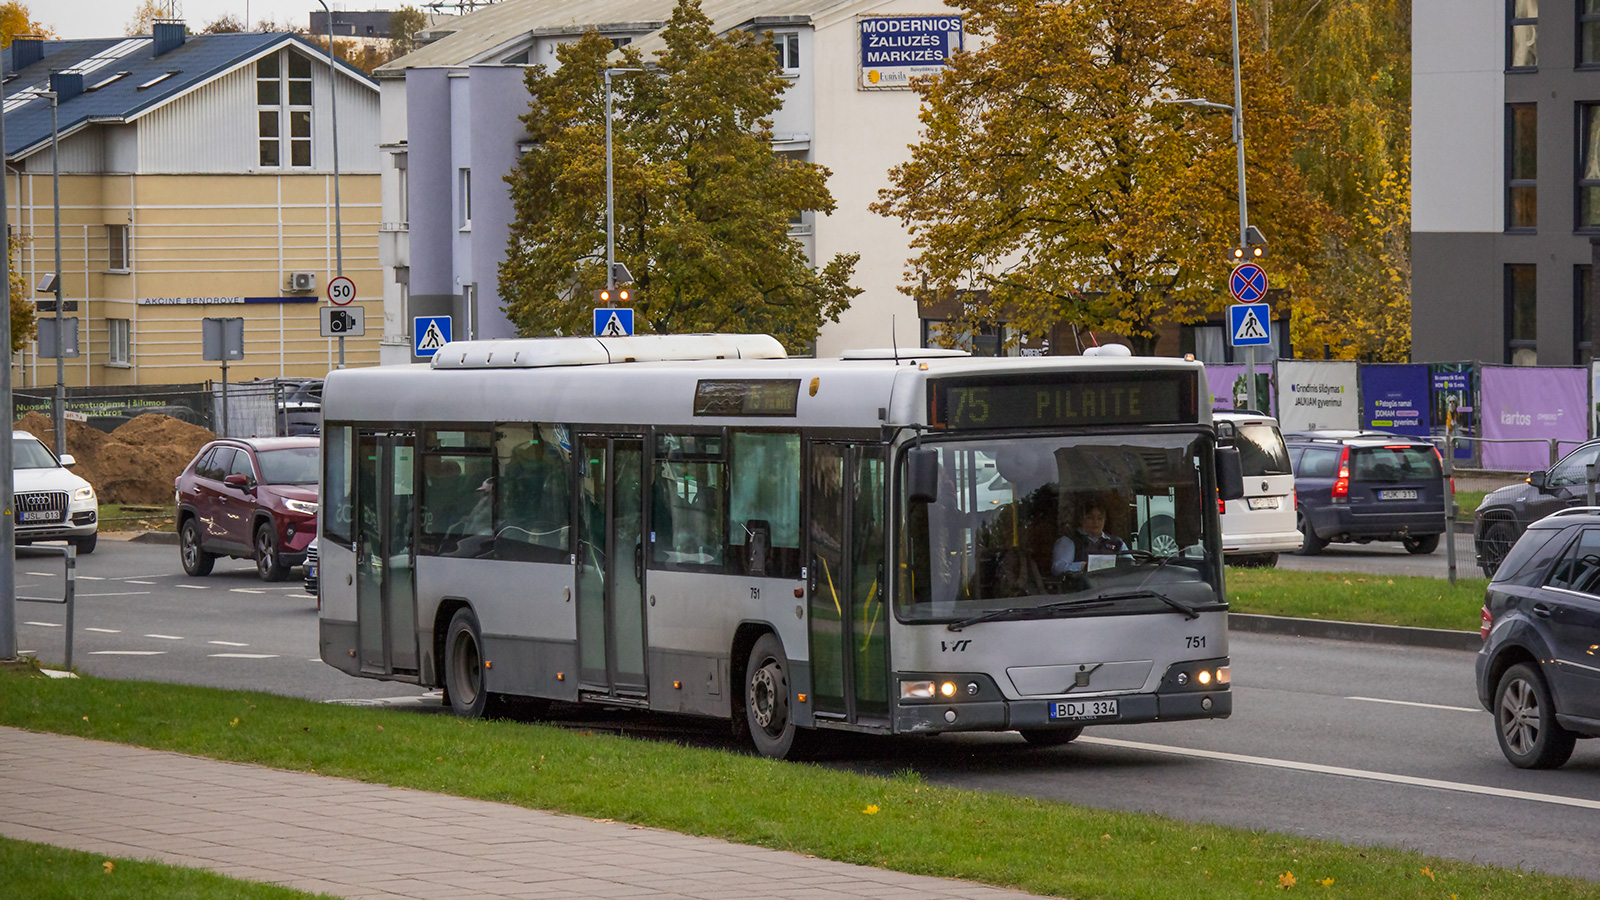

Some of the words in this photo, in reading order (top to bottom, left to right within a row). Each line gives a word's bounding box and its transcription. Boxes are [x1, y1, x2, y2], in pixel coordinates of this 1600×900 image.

[863, 19, 960, 32] MODERNIOS
[869, 34, 940, 47] ŽALIUZĖS
[868, 48, 944, 62] MARKIZĖS
[333, 285, 350, 297] 50
[952, 388, 989, 422] 75
[1037, 388, 1141, 418] PILAITE
[1501, 411, 1531, 426] kartos
[25, 512, 40, 520] JSL
[45, 511, 59, 519] 013
[750, 587, 760, 600] 751
[1185, 636, 1206, 648] 751
[1058, 704, 1084, 716] BDJ
[1093, 702, 1115, 714] 334
